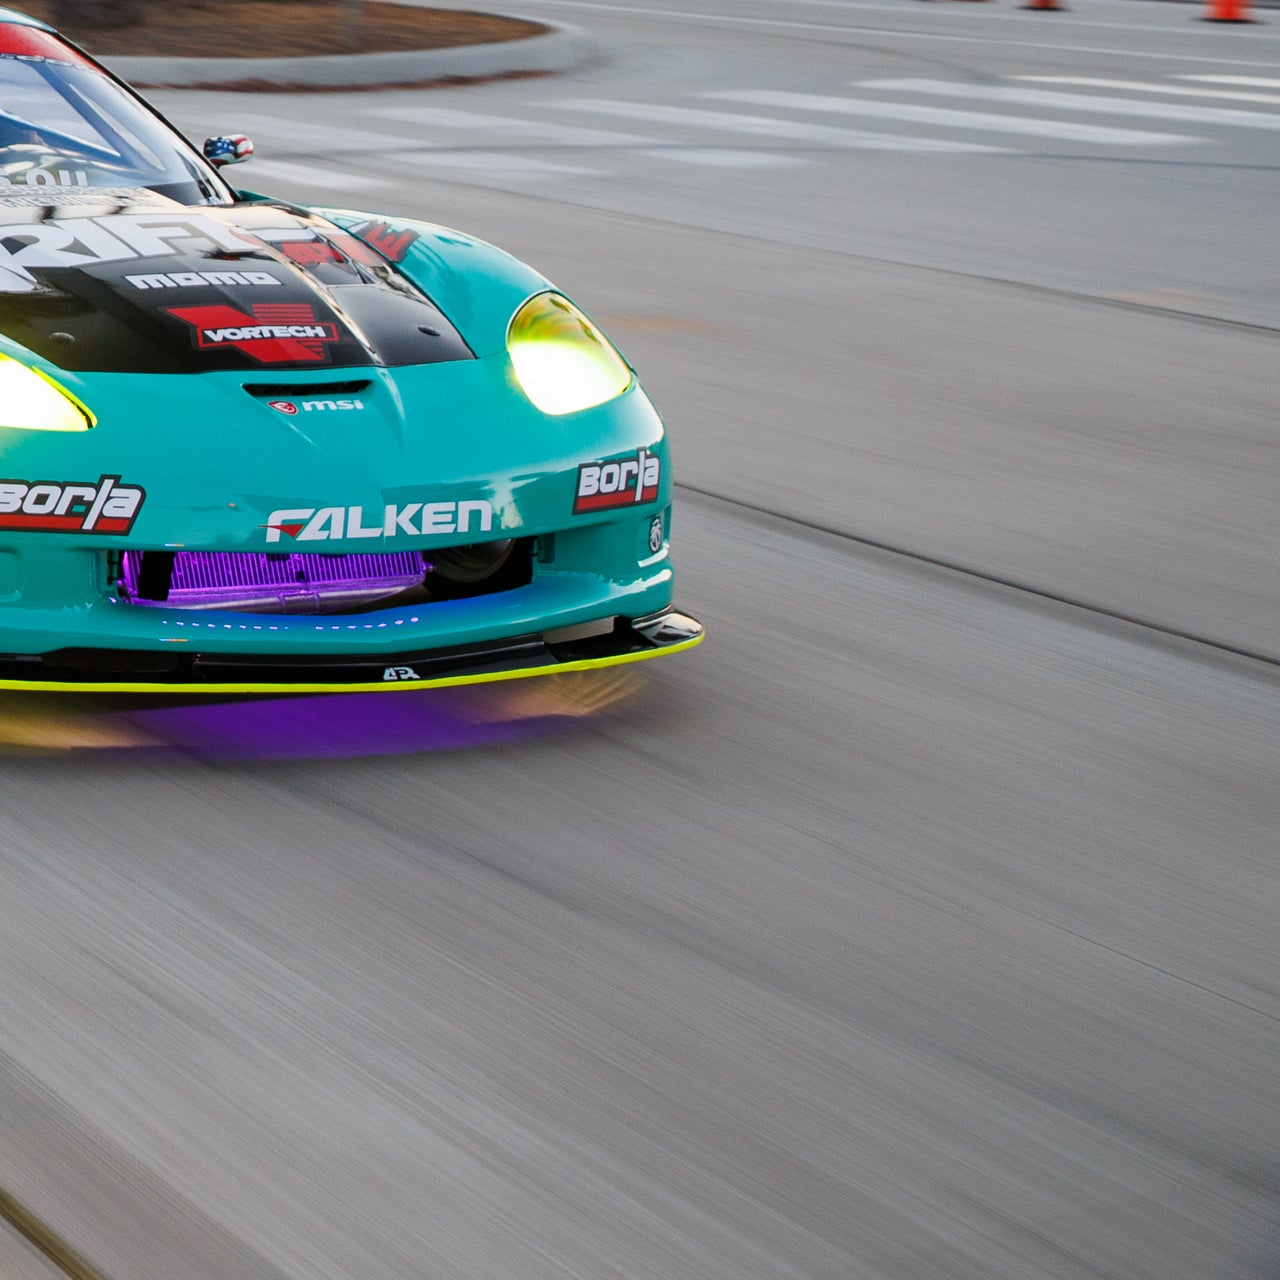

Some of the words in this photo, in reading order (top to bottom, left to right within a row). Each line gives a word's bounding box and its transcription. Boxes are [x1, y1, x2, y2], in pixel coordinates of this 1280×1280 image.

[203, 325, 328, 343] VORTECH
[302, 399, 365, 412] msi
[259, 500, 492, 544] FALKEN
